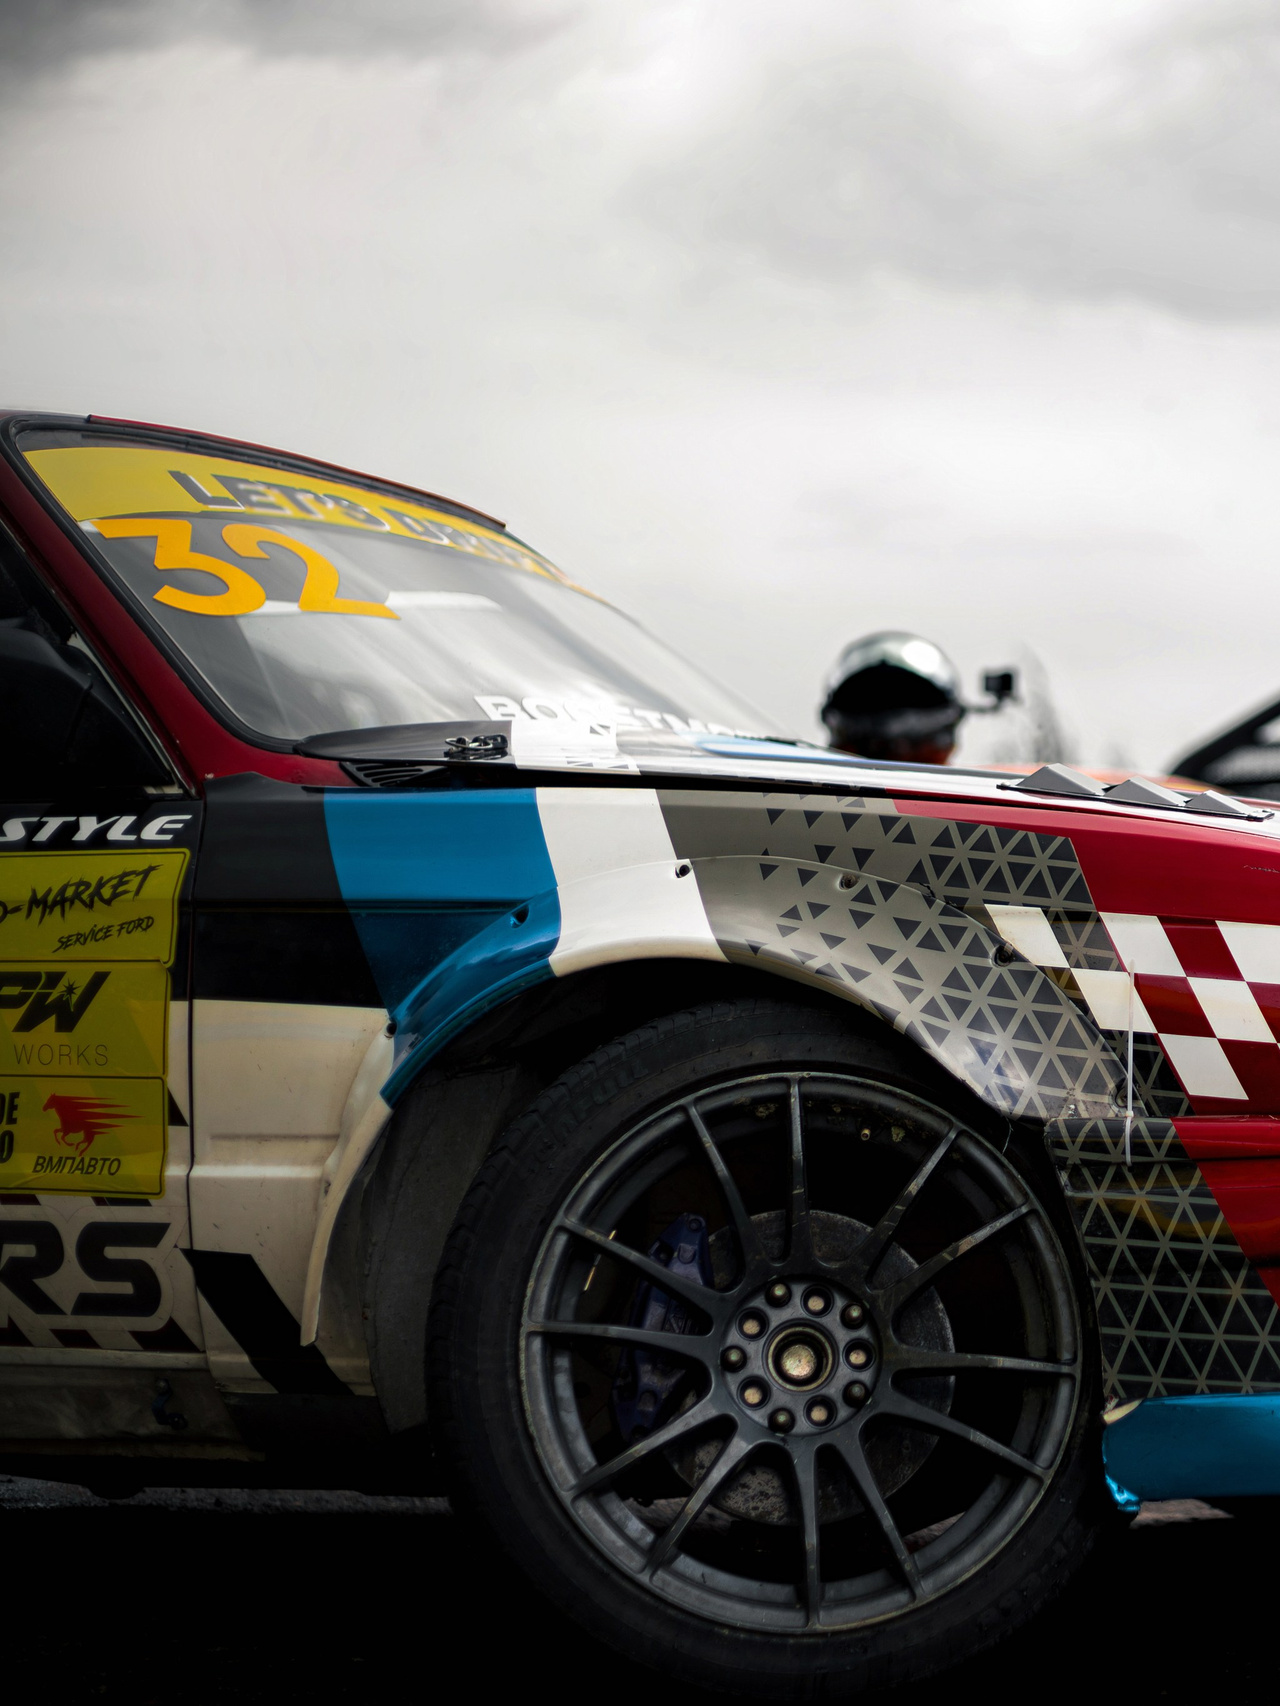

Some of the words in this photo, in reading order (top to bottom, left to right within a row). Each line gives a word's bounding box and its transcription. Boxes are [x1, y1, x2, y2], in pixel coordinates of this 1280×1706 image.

[98, 519, 401, 620] 32
[0, 815, 193, 842] STYLE
[51, 924, 115, 953] SERVICE
[116, 916, 155, 938] FORD
[13, 1043, 109, 1067] WORKS
[32, 1155, 122, 1176] ВМПАВТО
[0, 1219, 172, 1318] RS
